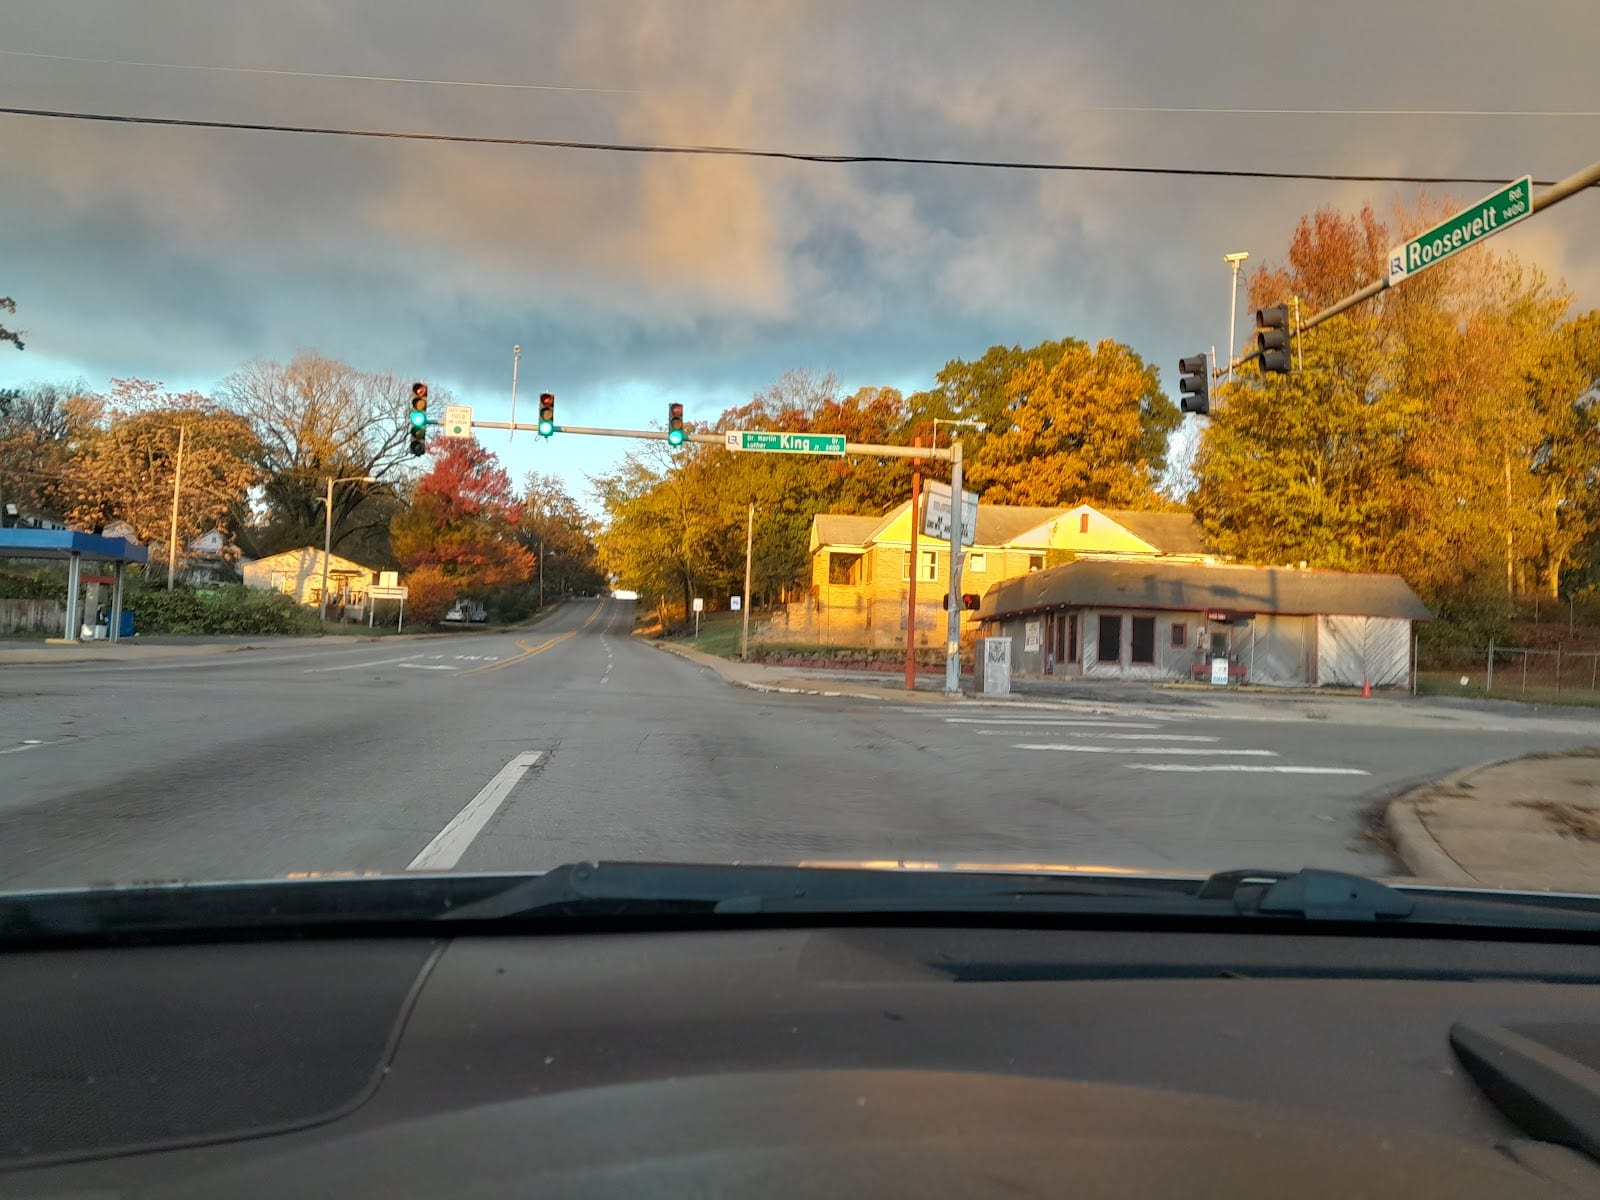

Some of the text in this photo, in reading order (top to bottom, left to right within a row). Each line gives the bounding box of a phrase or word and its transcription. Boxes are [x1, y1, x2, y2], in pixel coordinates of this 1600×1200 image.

[1502, 201, 1525, 220] 1400
[1409, 206, 1497, 269] Roosevelt
[780, 434, 810, 451] King
